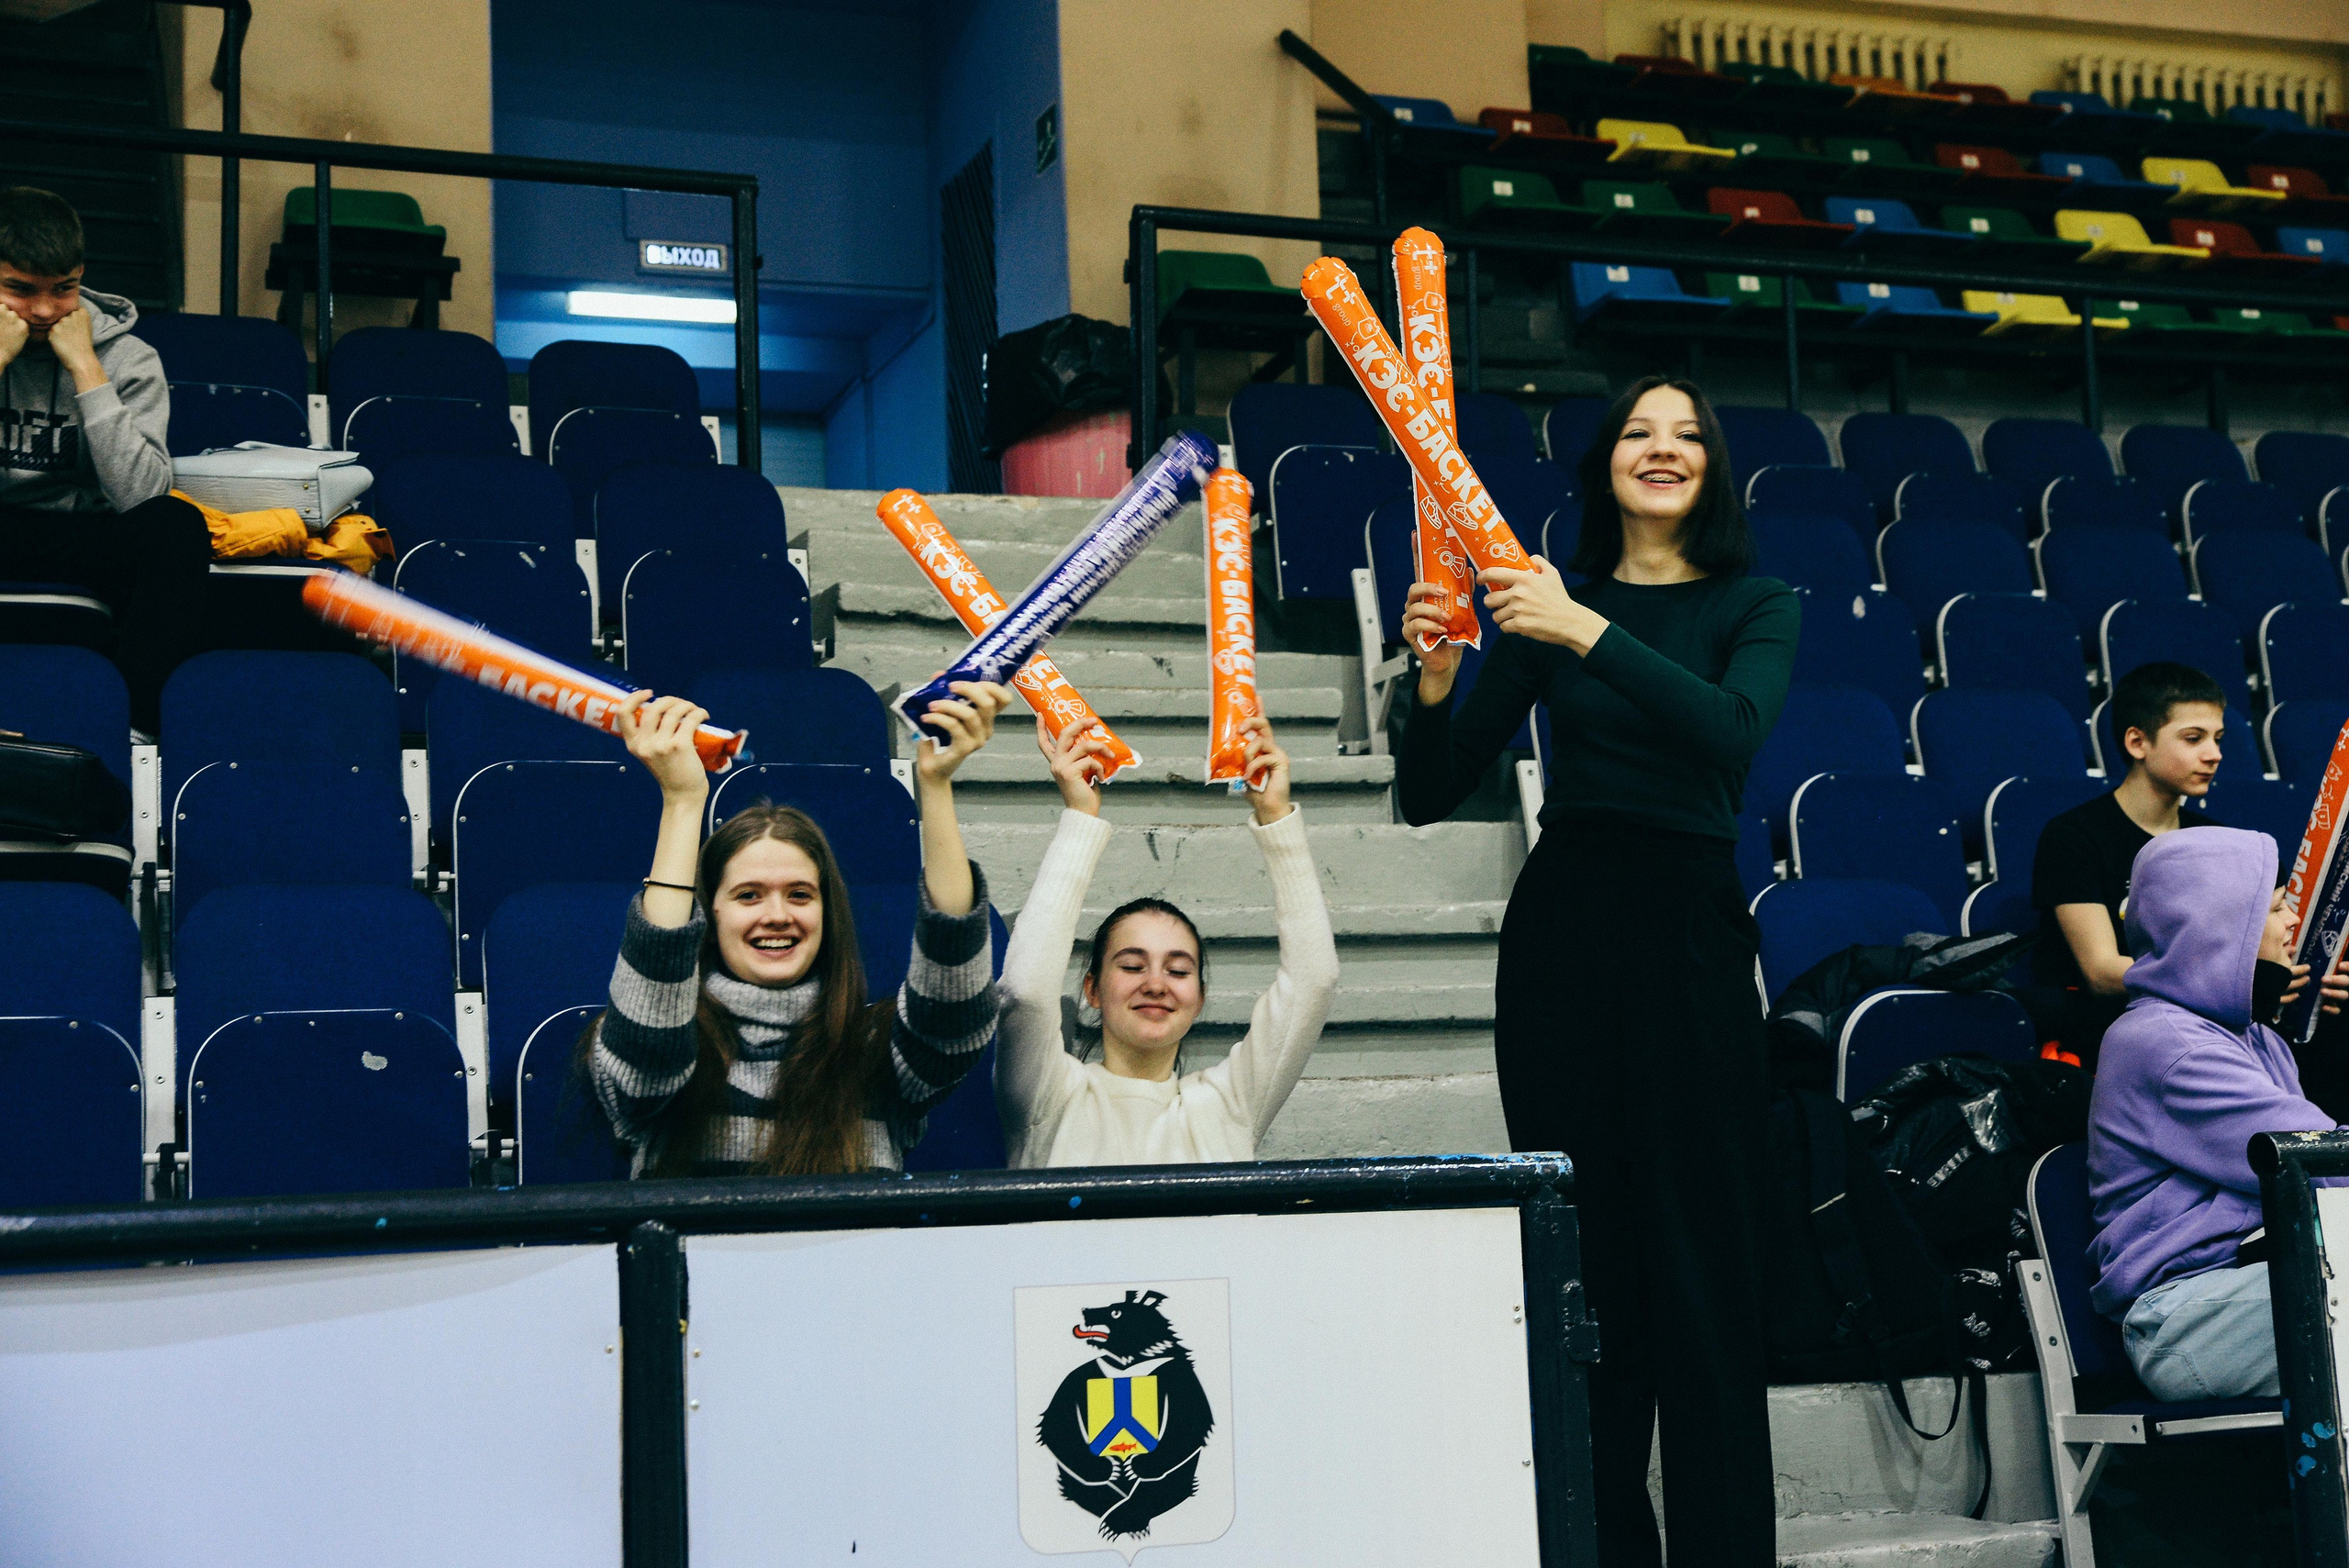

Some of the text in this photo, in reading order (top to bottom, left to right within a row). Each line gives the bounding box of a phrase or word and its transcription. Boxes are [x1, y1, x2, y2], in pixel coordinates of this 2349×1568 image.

[1331, 303, 1352, 327] group
[1353, 339, 1505, 533] КЭС-БАСКЕТ
[919, 537, 1074, 691] КЭС-БЕТ
